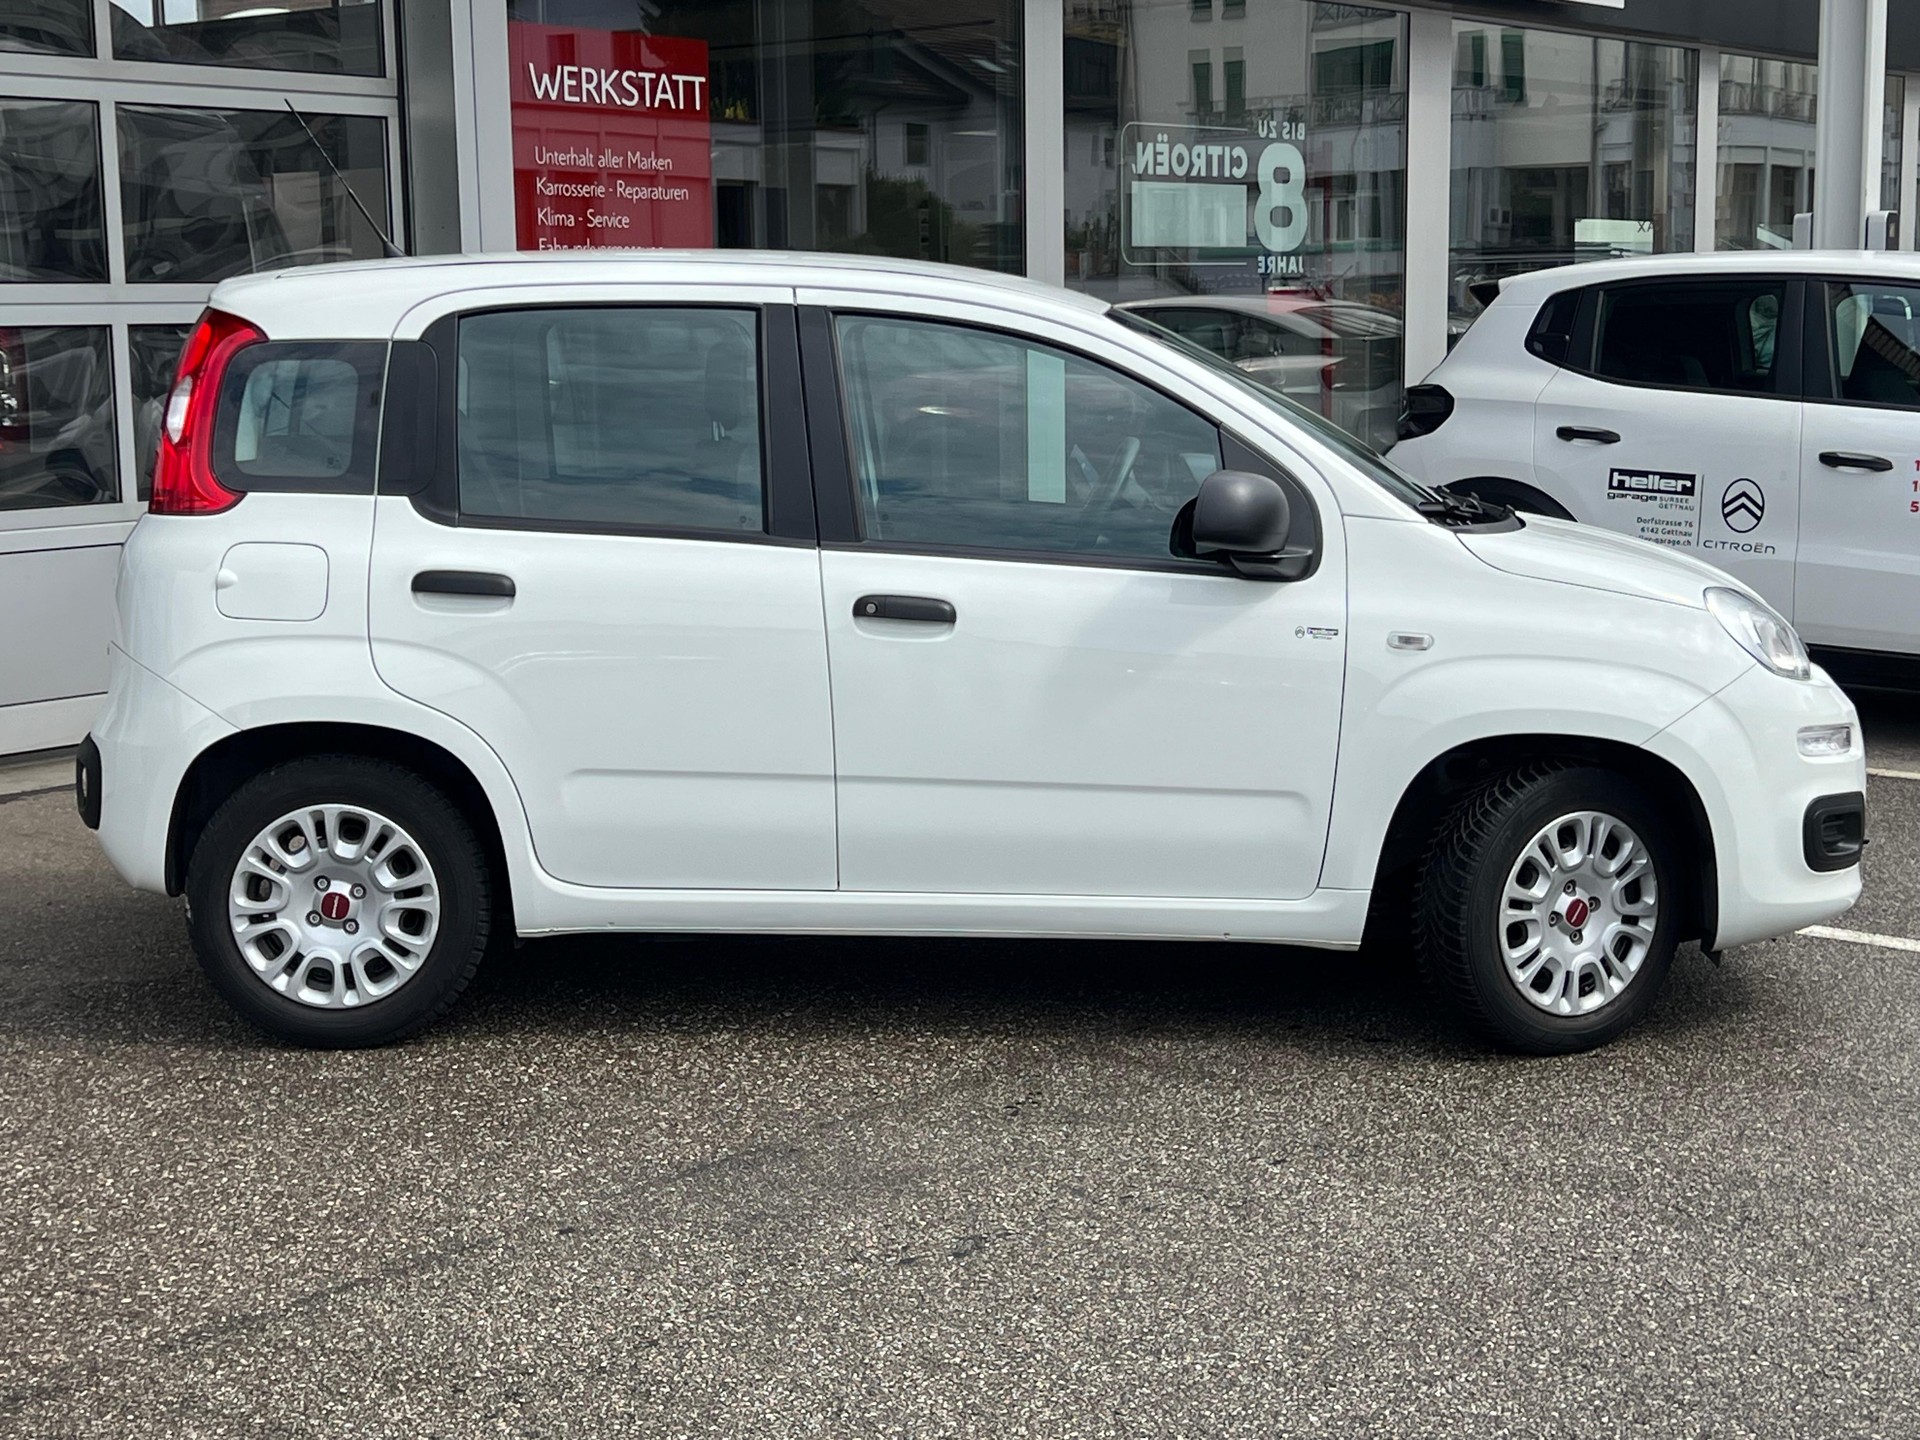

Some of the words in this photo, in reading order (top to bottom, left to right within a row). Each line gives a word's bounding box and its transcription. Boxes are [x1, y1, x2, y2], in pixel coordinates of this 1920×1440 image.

[528, 62, 706, 111] WERKSTATT
[534, 146, 595, 168] Unterhalt
[597, 147, 624, 169] aller
[627, 150, 673, 171] Marken
[536, 176, 606, 198] Karrosserie
[616, 179, 689, 204] Reparaturen
[537, 207, 575, 227] Klima
[586, 208, 630, 229] Service
[1612, 471, 1692, 492] heller
[1607, 491, 1658, 502] garage
[1658, 503, 1695, 512] GETTNAU
[1636, 516, 1683, 528] Dorfstrasse
[1684, 520, 1694, 528] 76
[1640, 526, 1660, 535] 6142
[1660, 527, 1693, 537] Gettnau
